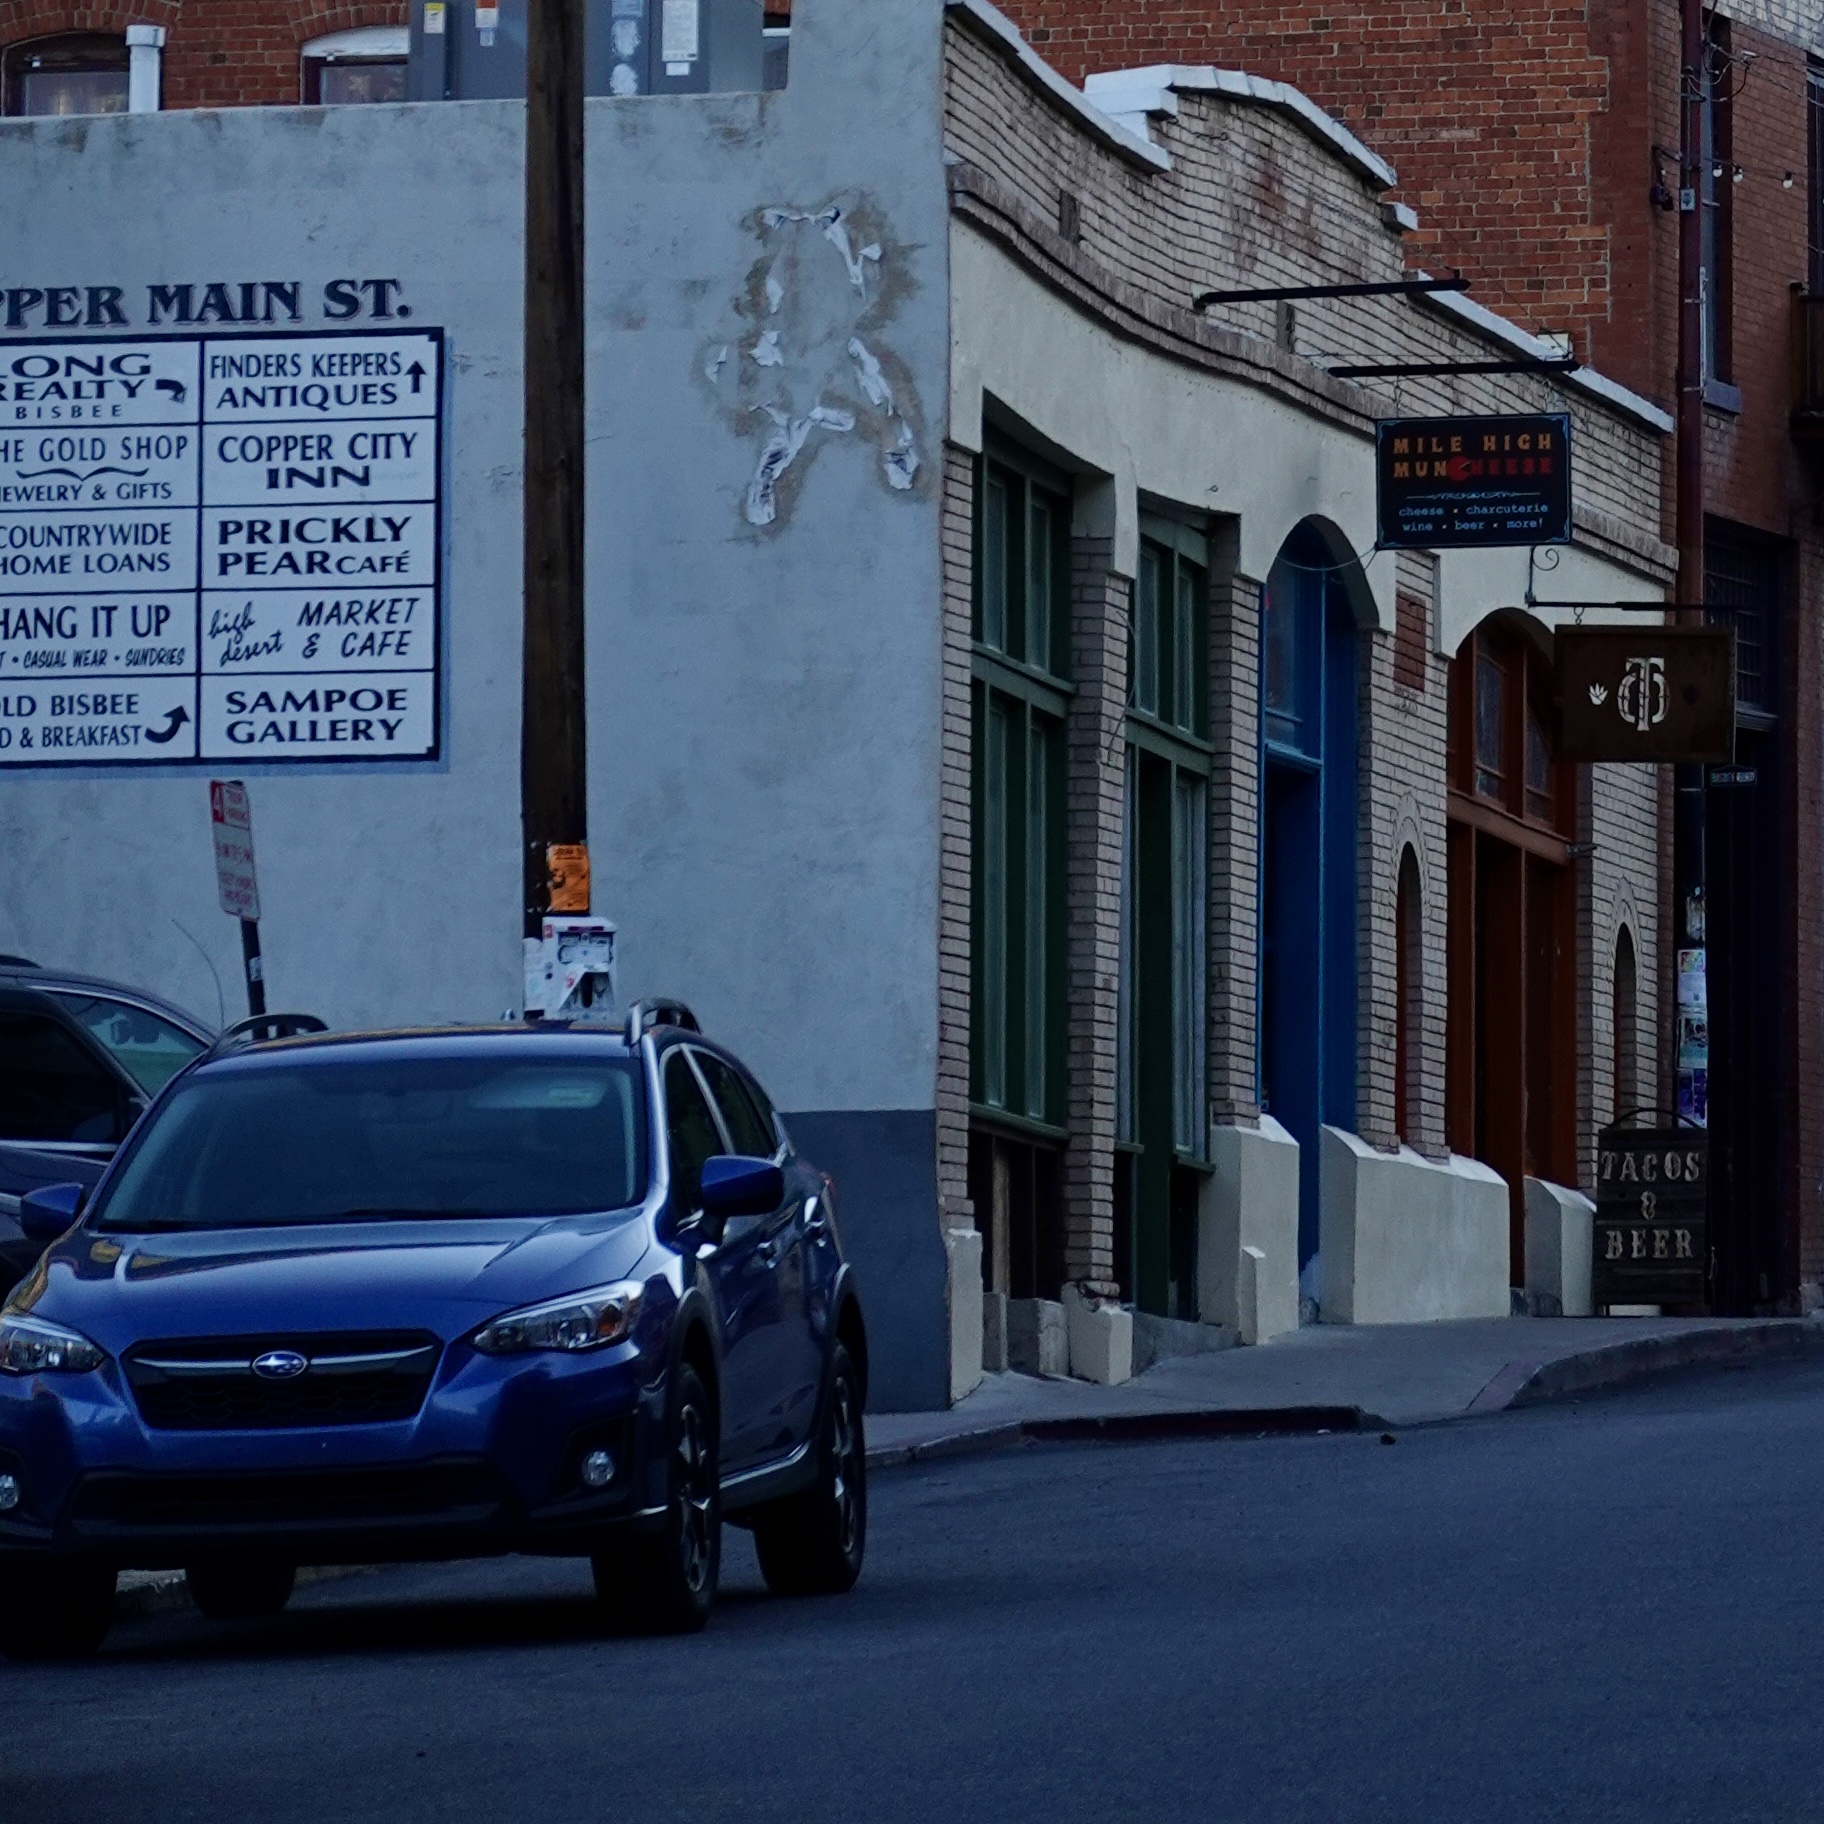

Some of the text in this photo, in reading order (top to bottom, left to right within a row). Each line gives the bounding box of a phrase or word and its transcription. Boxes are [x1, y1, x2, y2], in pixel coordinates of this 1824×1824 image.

[147, 281, 302, 326] MAIN
[323, 278, 411, 320] ST.
[209, 351, 402, 380] FINDERS KEEPERS
[216, 382, 399, 412] ANTIQUES
[15, 404, 123, 421] BISBEE
[39, 436, 107, 462] GOLD
[120, 434, 189, 460] SHOP
[217, 431, 418, 464] COPPER CITY
[1393, 433, 1552, 455] MILE HIGH
[266, 465, 371, 490] INN
[0, 481, 172, 503] EWELRY & GIFTS
[1398, 503, 1549, 517] cheese charcuterie
[217, 516, 412, 545] PRICKLY
[1402, 518, 1544, 532] wine beer more!
[83, 552, 171, 574] LOANS
[216, 550, 411, 577] PEAR CAFÉ
[91, 604, 118, 639] IT
[130, 604, 171, 637] UP
[206, 601, 257, 643] high
[296, 596, 421, 628] MARKET
[23, 649, 67, 669] CASUAL
[72, 648, 109, 668] WEAR
[125, 646, 186, 668] SUNDRIES
[219, 629, 285, 669] desert
[340, 629, 413, 659] CAFE
[0, 693, 140, 718] LD BISBEE
[225, 688, 409, 715] SAMPOE
[19, 726, 34, 749] &
[41, 724, 142, 749] BREAKFAST
[226, 717, 405, 745] GALLERY
[1601, 1151, 1700, 1181] TACOS
[1604, 1228, 1694, 1261] BEER
